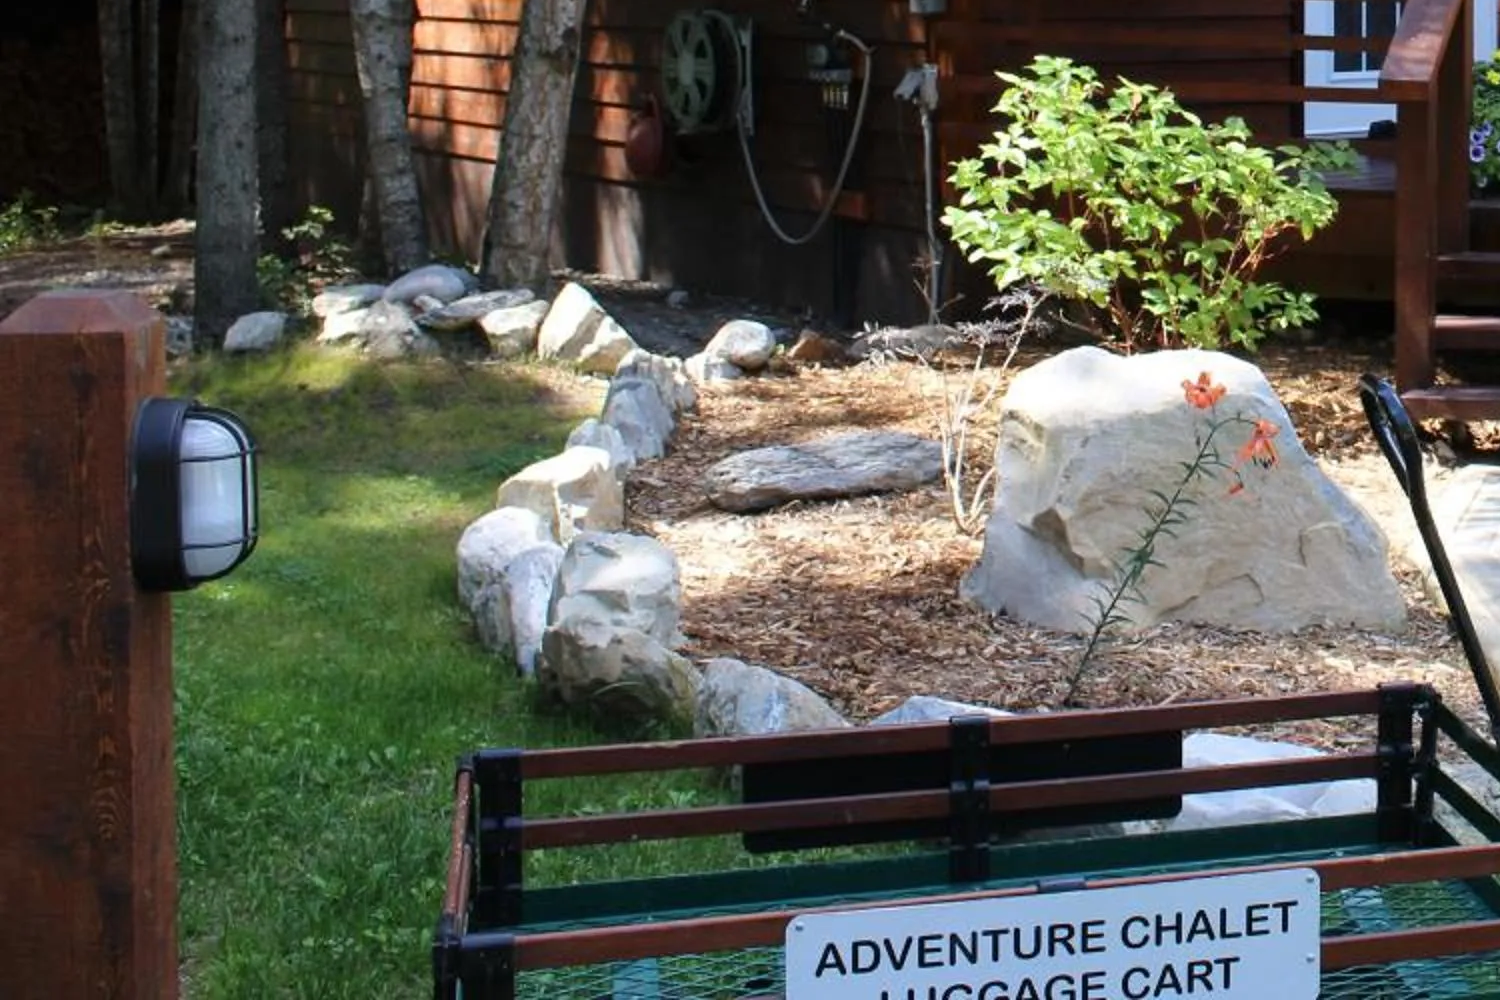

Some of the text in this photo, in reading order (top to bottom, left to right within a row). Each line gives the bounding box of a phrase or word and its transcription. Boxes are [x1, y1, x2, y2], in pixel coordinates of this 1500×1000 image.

[815, 900, 1299, 979] ADVENTURE CHALET
[880, 957, 1241, 1000] GAGE CART
